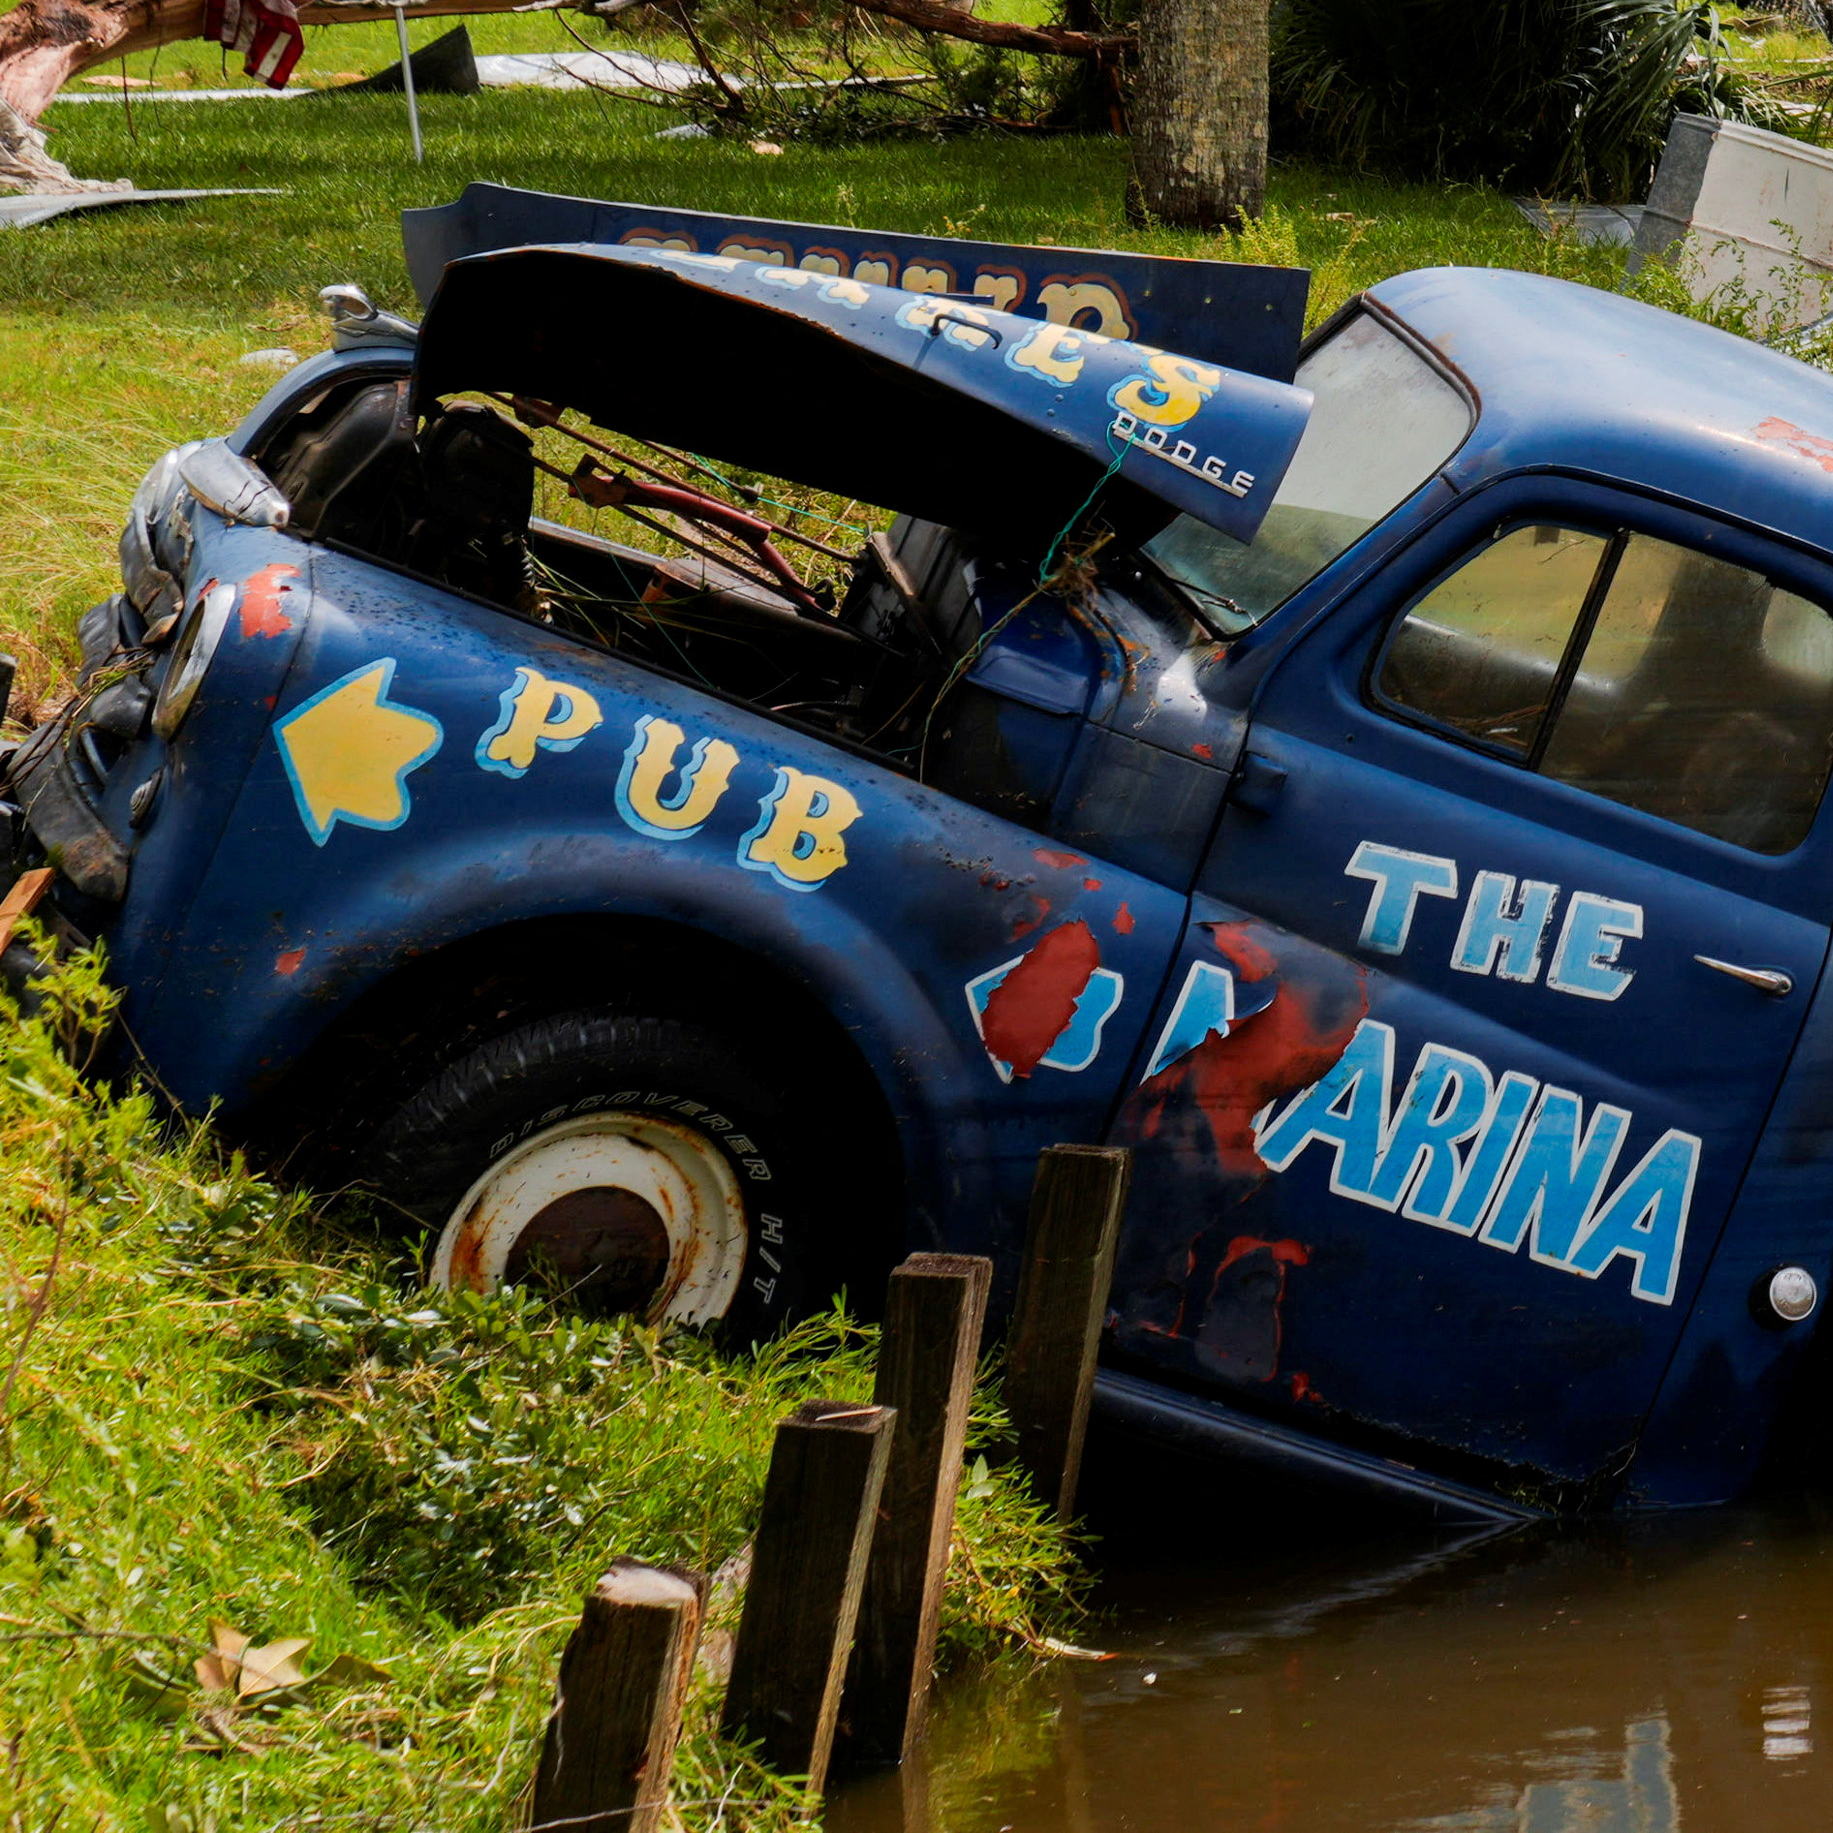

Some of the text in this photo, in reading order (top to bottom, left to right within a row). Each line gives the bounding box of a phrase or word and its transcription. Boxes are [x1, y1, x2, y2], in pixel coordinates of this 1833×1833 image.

[1112, 412, 1255, 495] DODGE
[474, 667, 864, 893] PUB
[1344, 840, 1643, 1001] THE
[490, 1091, 784, 1304] DISCOVERER H/T
[1141, 960, 1702, 1306] ARINA
